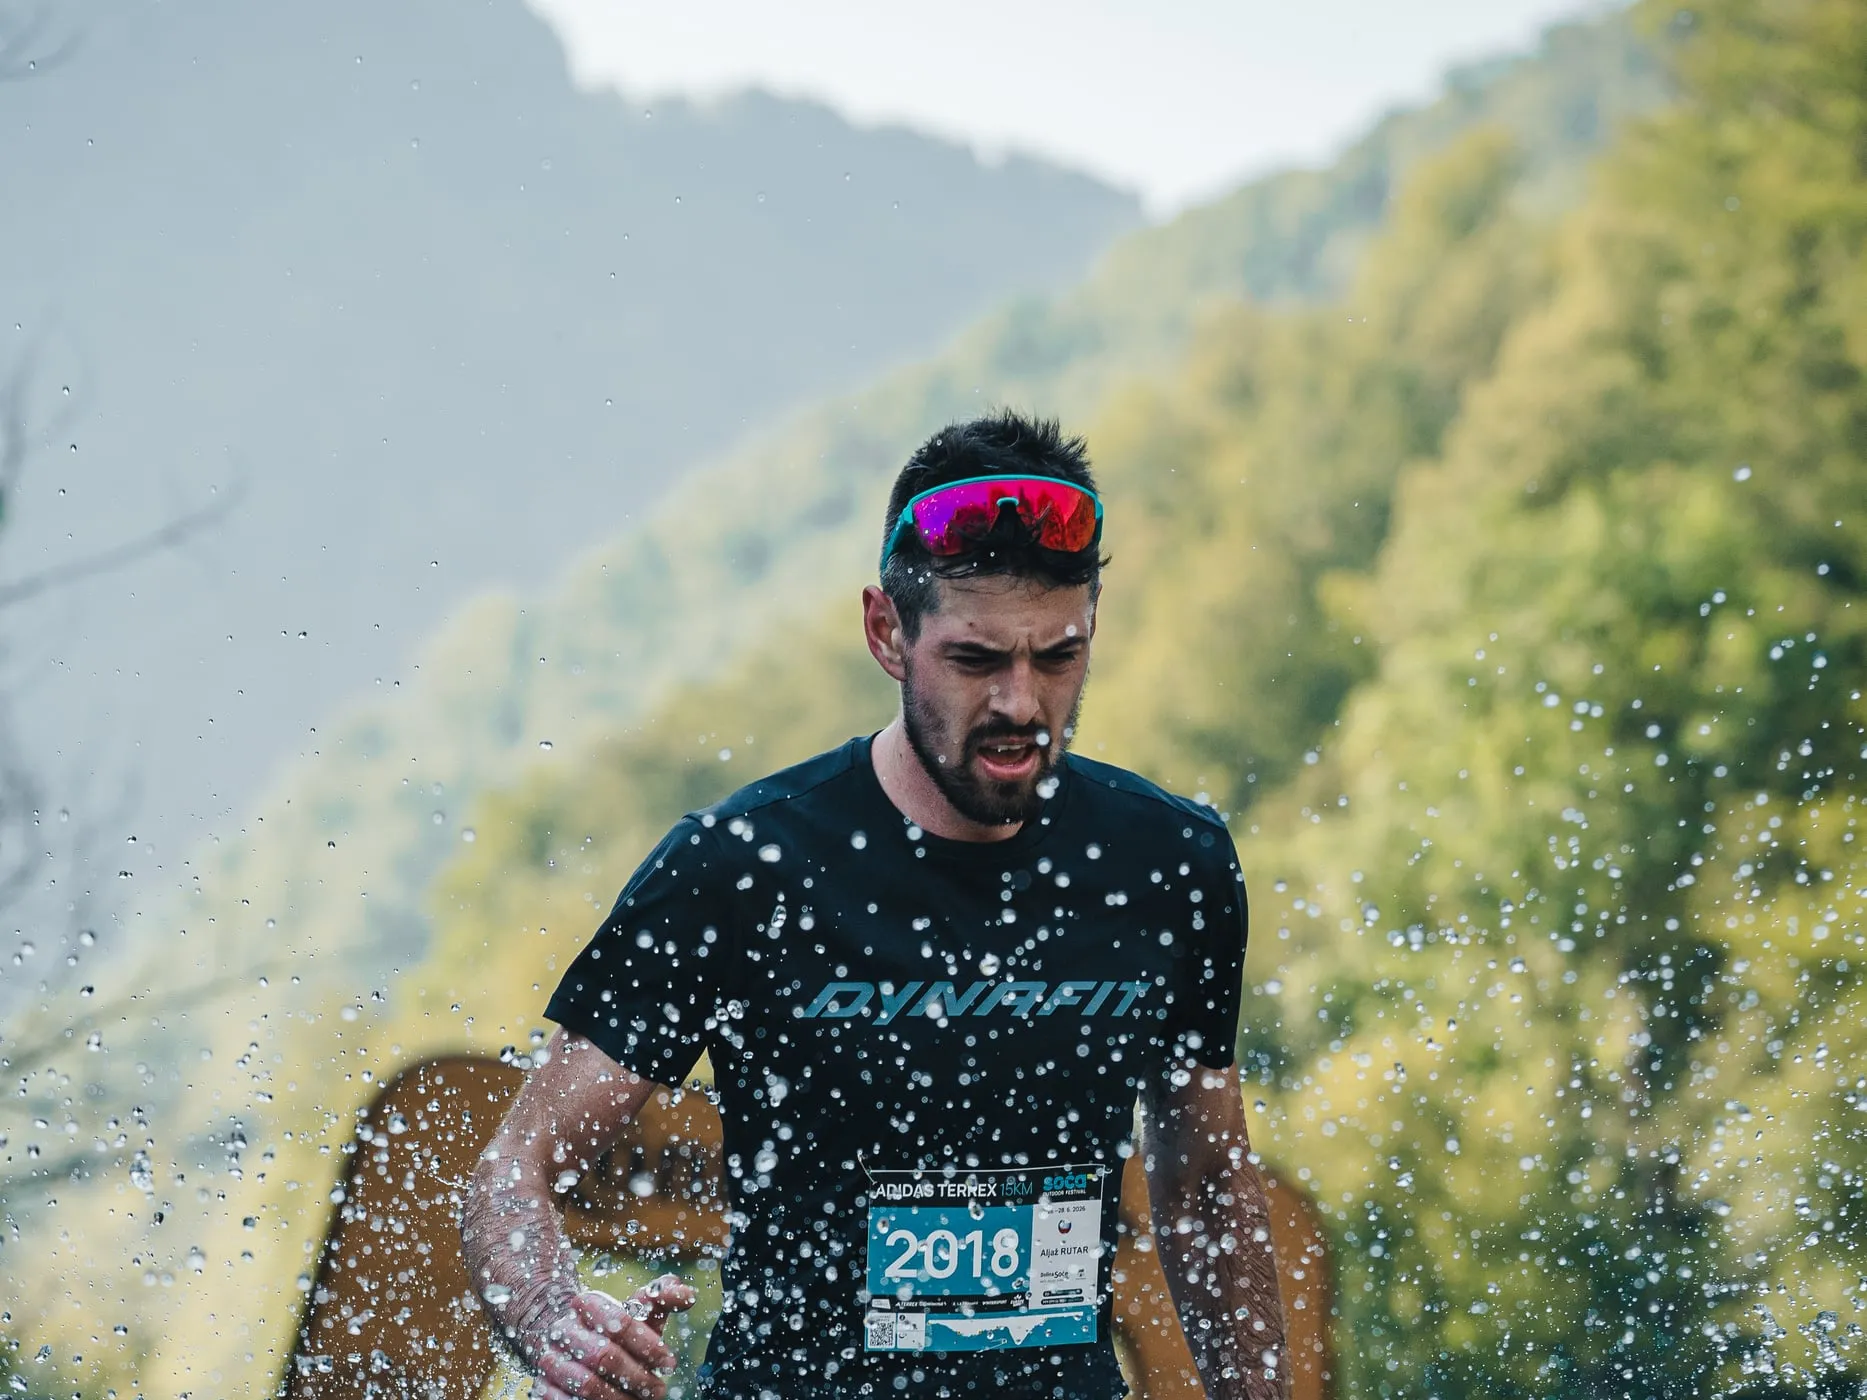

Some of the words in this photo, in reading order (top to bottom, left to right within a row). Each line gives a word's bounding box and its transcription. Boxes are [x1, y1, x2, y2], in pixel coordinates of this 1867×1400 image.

[802, 981, 1152, 1025] DYNAFIT
[876, 1184, 934, 1198] ADIDAS
[937, 1183, 997, 1197] TERREX
[1000, 1182, 1033, 1196] 15KM
[885, 1228, 1019, 1279] 2018
[1040, 1247, 1059, 1258] Aljaž
[1060, 1246, 1089, 1256] RUTAR
